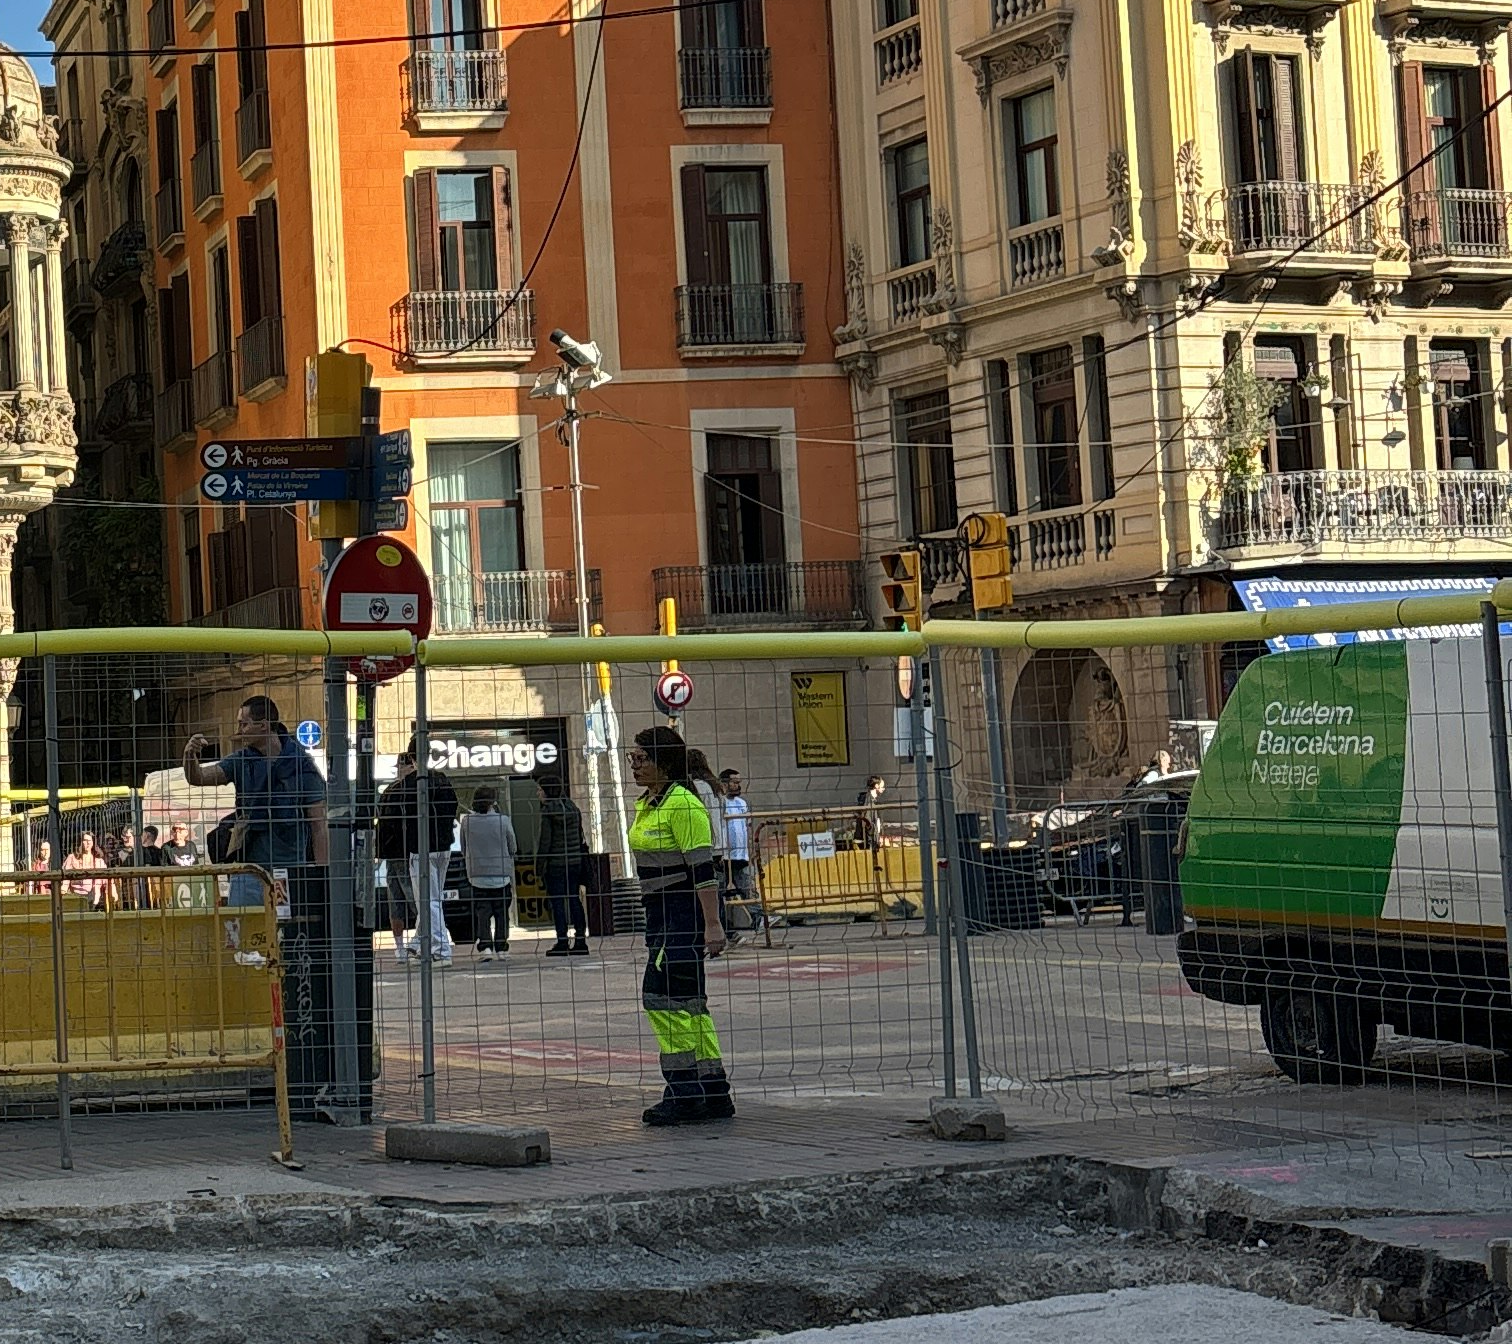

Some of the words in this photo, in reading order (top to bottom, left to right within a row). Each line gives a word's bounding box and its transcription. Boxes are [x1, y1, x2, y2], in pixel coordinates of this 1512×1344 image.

[797, 692, 834, 701] Western
[1264, 700, 1354, 726] Cuidem
[426, 739, 558, 773] Change
[1257, 729, 1374, 756] Barcelona
[1251, 759, 1320, 790] Neteja
